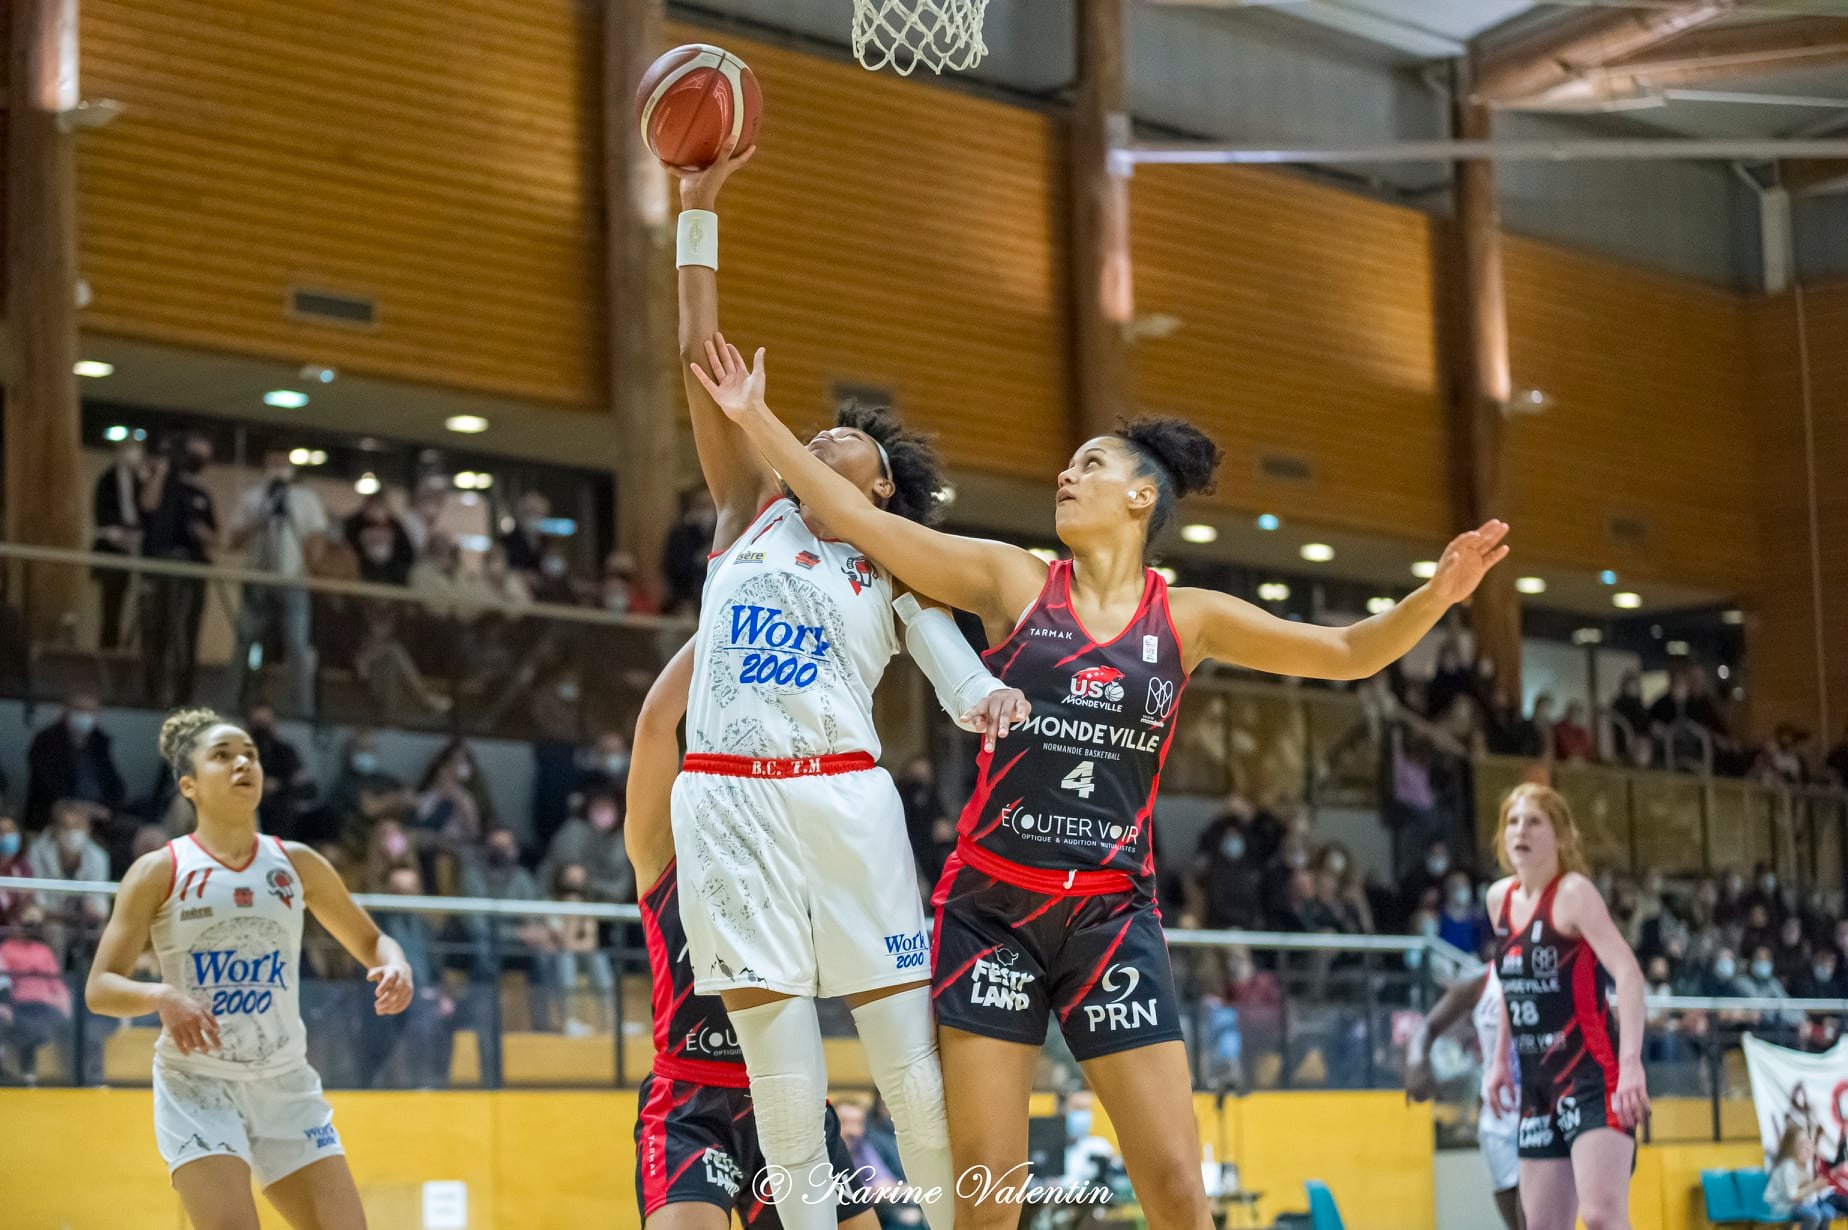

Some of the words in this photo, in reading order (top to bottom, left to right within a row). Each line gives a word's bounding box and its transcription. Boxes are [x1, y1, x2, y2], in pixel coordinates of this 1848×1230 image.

[1029, 628, 1073, 640] TARMAK
[739, 653, 818, 688] 2000
[1061, 694, 1123, 712] MONDEVILLE
[1010, 715, 1160, 753] MONDEVILLE
[1043, 742, 1083, 756] NORMANDIE
[1085, 748, 1121, 761] BASKETBALL
[1061, 760, 1095, 798] 4
[1021, 833, 1052, 843] OPTIQUE
[1063, 838, 1097, 847] AUDITION
[1100, 841, 1136, 853] MUTUALISTES
[1098, 819, 1139, 845] VOIR
[884, 931, 929, 954] Work
[191, 949, 287, 991] Work
[895, 952, 924, 969] 2000
[971, 958, 1036, 992] FESTY
[211, 989, 273, 1016] 2000
[970, 981, 1030, 1011] LAND
[1083, 998, 1158, 1032] PRN
[1510, 1000, 1540, 1026] 28
